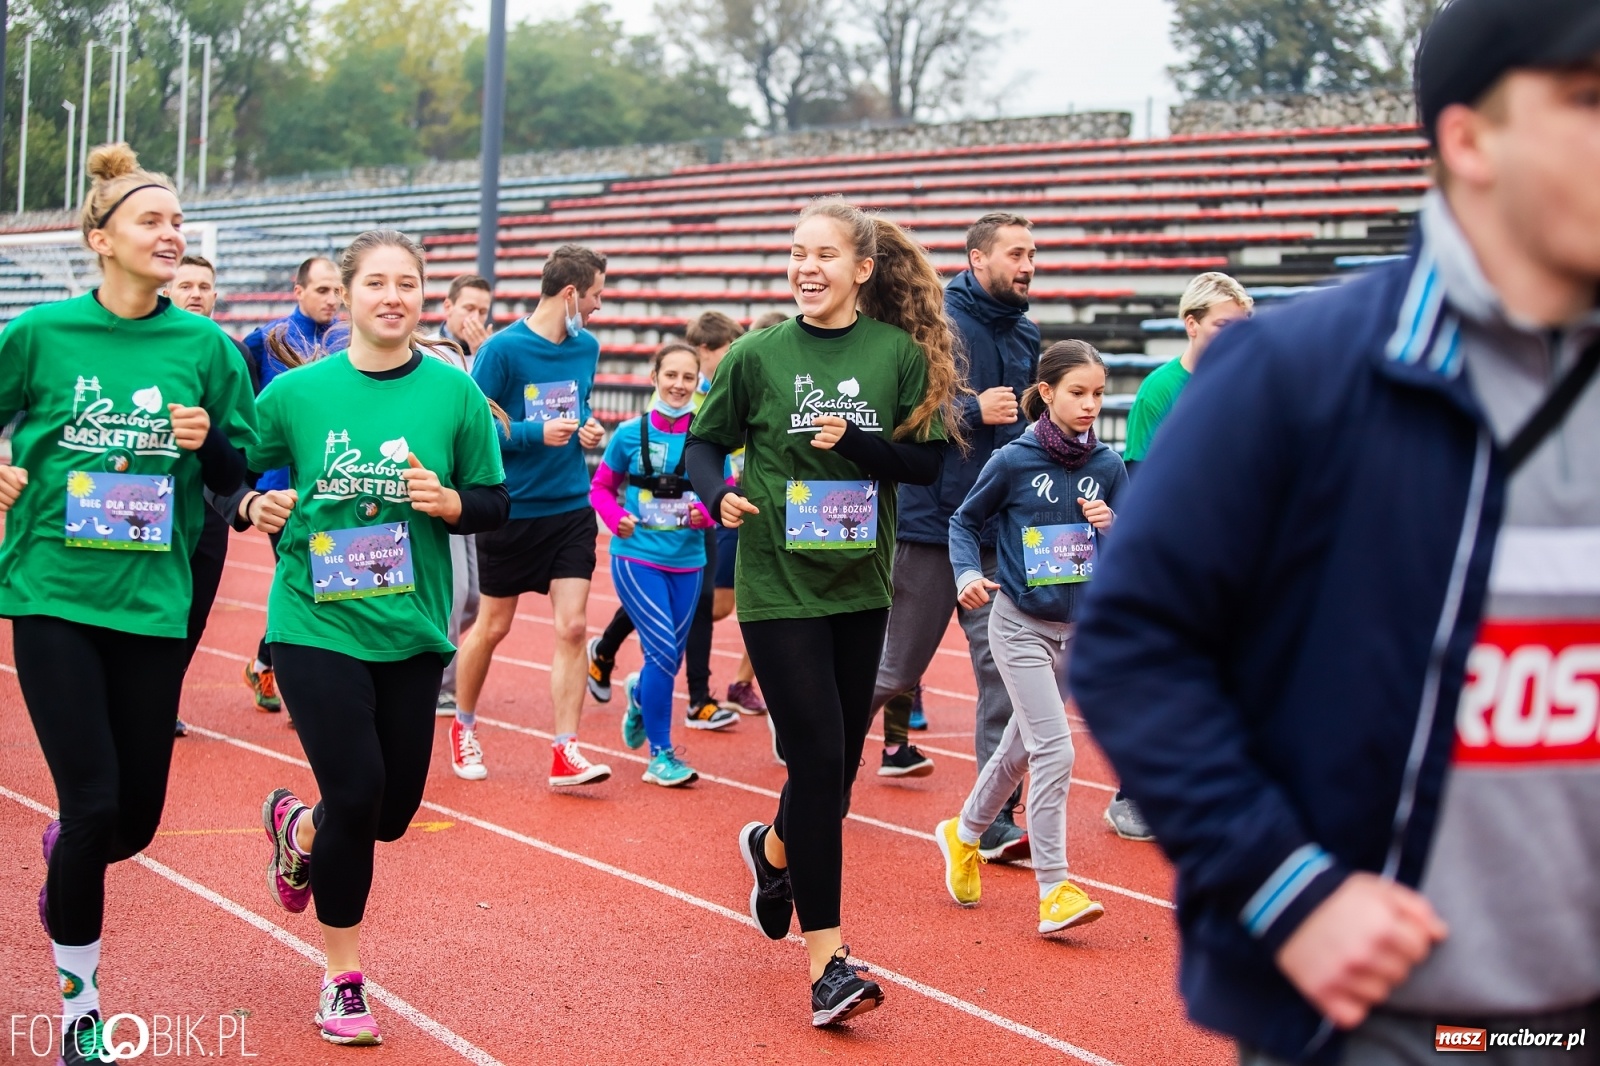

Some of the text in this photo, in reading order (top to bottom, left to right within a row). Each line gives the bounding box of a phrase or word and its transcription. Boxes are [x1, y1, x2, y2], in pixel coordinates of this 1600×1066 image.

[64, 425, 178, 450] BASKETBALL
[327, 449, 409, 480] Racibór
[317, 478, 411, 496] BASKETBA
[80, 498, 102, 509] BIEG
[106, 500, 125, 511] DLA
[799, 505, 818, 514] BIEG
[822, 505, 838, 514] DLA
[128, 525, 162, 541] 032
[840, 526, 869, 539] 055
[1034, 547, 1050, 555] BIEG
[1054, 545, 1068, 554] DLA
[324, 555, 344, 565] BIEG
[348, 552, 365, 563] DLA
[1072, 563, 1093, 577] 285
[373, 570, 404, 586] 041
[1455, 642, 1600, 748] ROS
